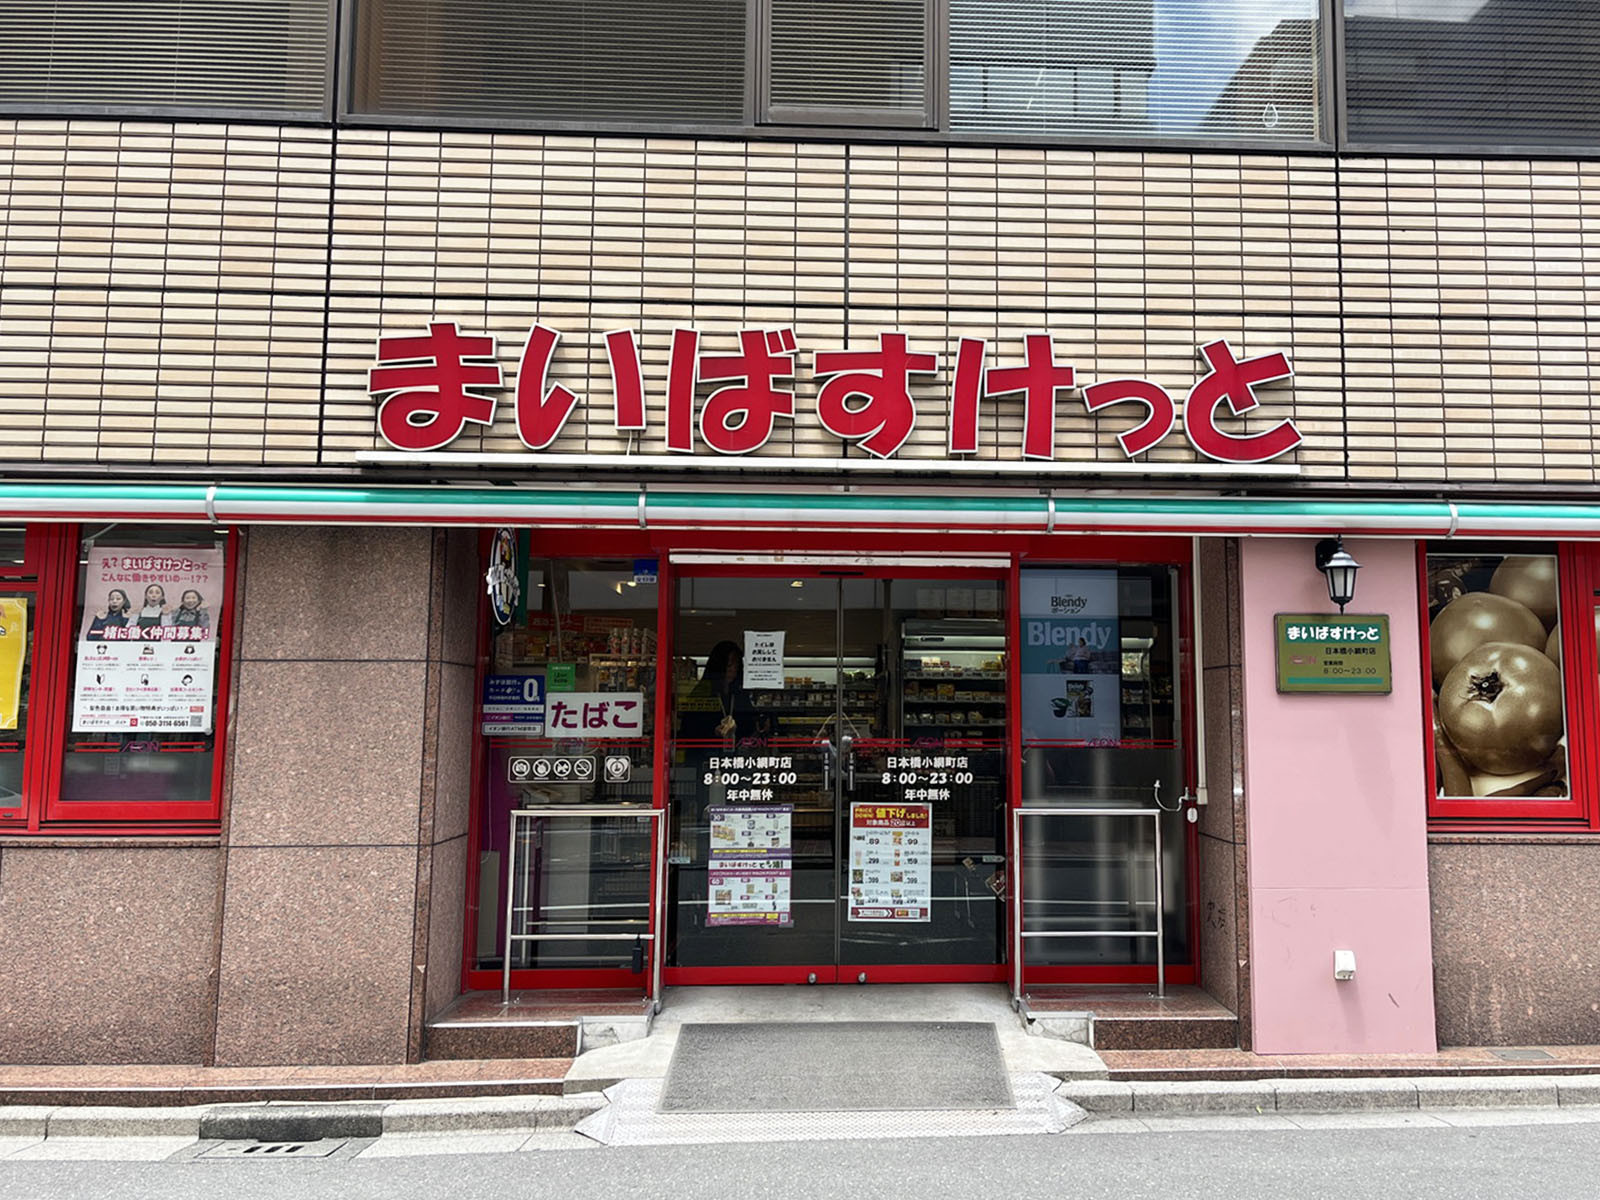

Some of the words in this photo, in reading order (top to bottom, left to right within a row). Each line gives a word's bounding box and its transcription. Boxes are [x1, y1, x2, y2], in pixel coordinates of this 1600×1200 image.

[368, 321, 1303, 463] まいばすけっと
[1050, 595, 1088, 608] Blendy
[1027, 621, 1112, 650] Blendy
[1287, 626, 1379, 641] まいばすけっと
[551, 701, 638, 729] たばこ
[709, 756, 792, 769] 日本橋小網町店
[887, 756, 969, 769] 日本橋小網町店
[726, 788, 773, 801] 年中無休
[904, 788, 951, 801] 年中無休
